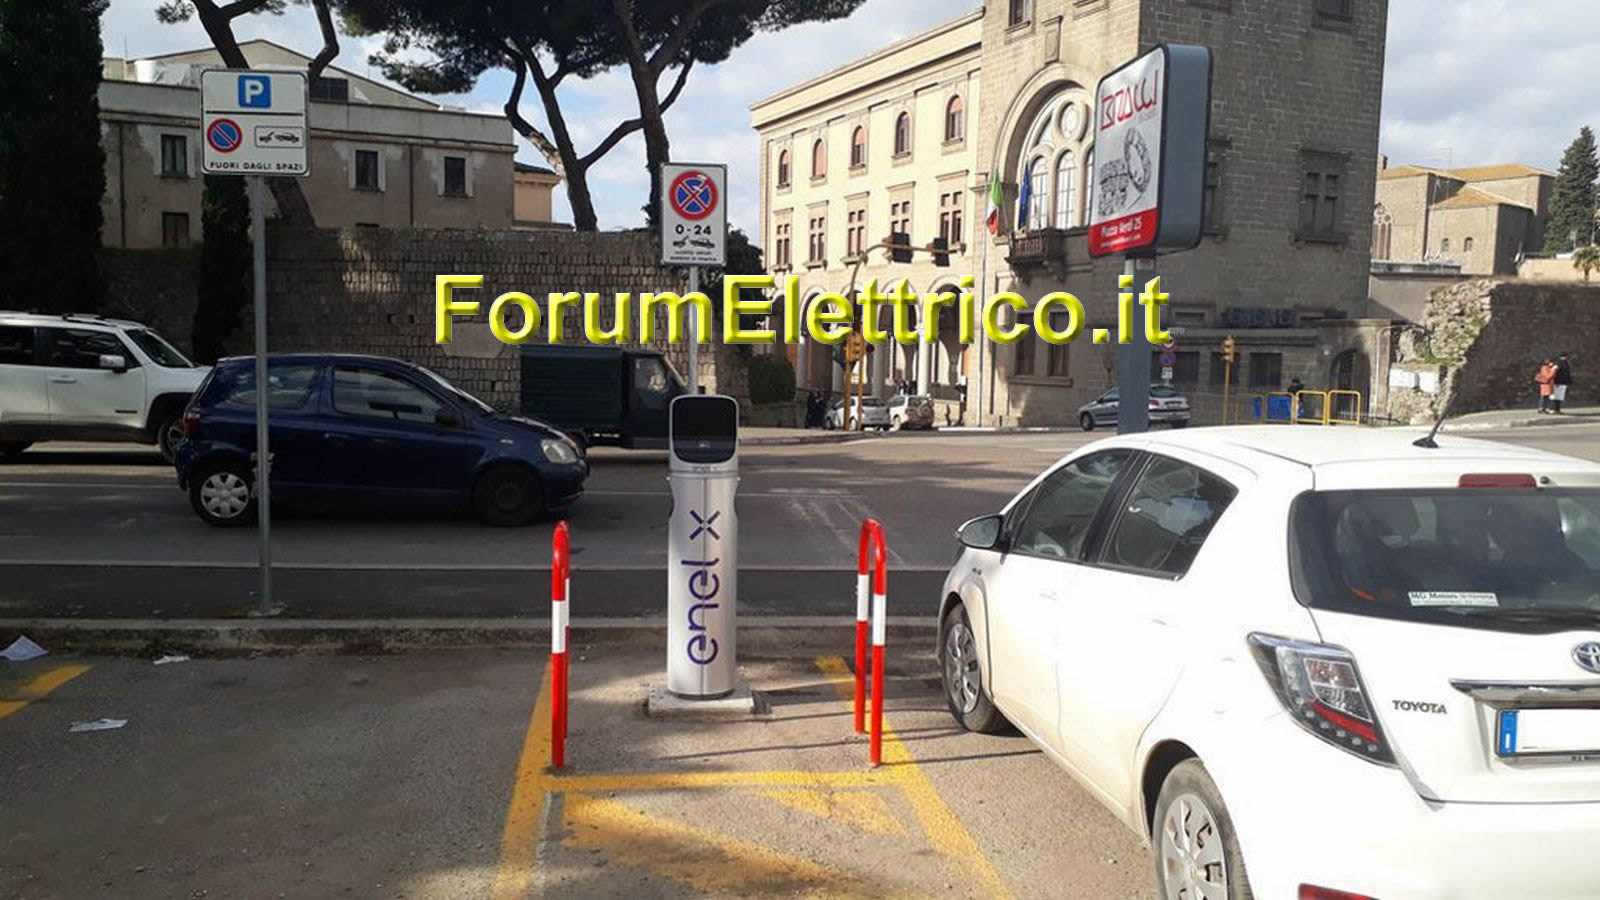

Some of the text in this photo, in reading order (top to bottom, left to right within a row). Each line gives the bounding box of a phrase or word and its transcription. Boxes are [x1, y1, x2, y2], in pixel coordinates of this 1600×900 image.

[244, 79, 264, 104] P
[210, 161, 303, 171] FUORI DAGLI SPAZI
[681, 557, 720, 666] enel
[1391, 699, 1448, 715] TOYOTA
